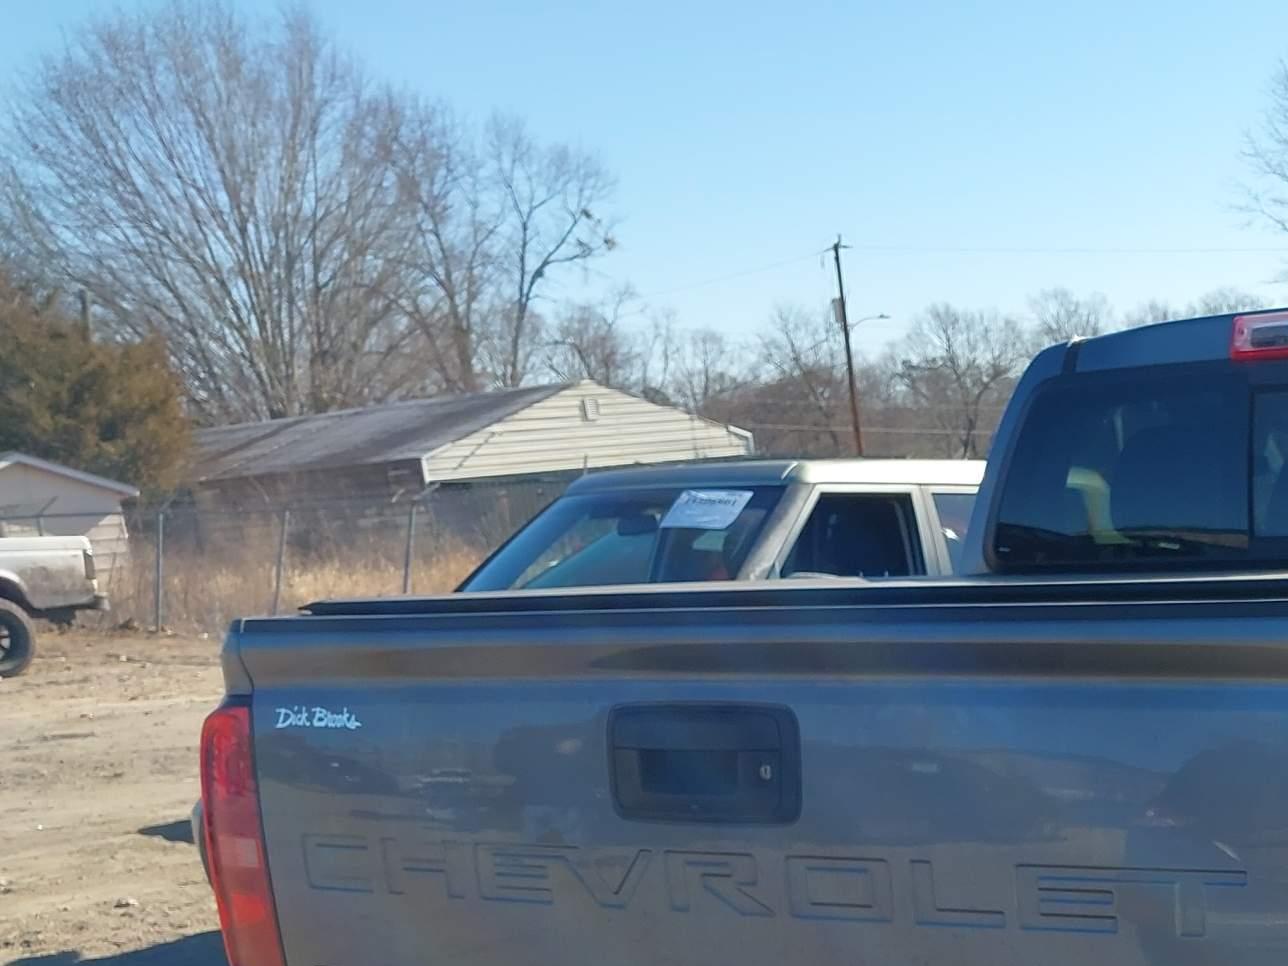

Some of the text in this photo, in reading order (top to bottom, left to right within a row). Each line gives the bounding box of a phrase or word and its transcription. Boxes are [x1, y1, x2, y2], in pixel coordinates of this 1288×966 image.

[275, 705, 362, 730] Dick Brooks
[302, 833, 1247, 940] CHEVROLET
